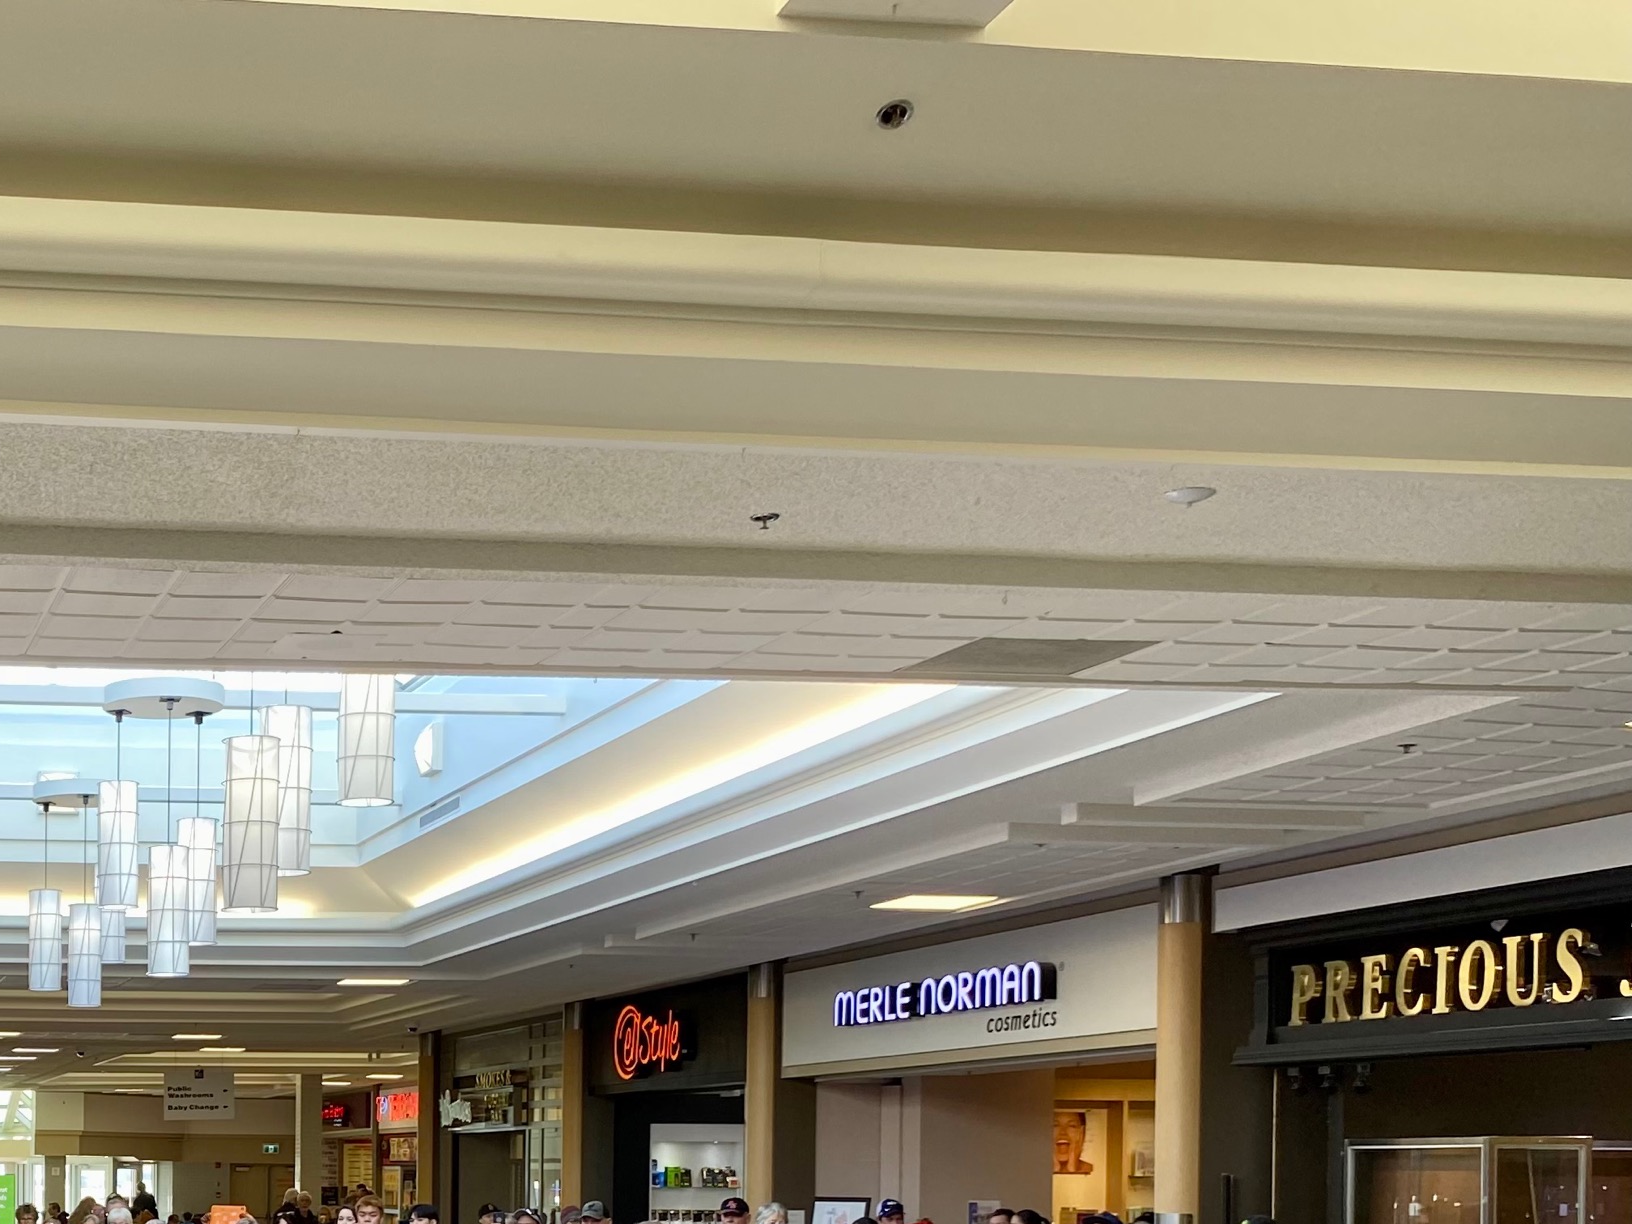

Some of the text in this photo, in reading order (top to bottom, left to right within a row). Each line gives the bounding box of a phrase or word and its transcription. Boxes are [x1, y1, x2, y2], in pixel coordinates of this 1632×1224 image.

[834, 961, 1042, 1027] MERLE NORMAN
[1288, 928, 1583, 1026] PRECIOUS
[986, 1007, 1057, 1033] cosmetics
